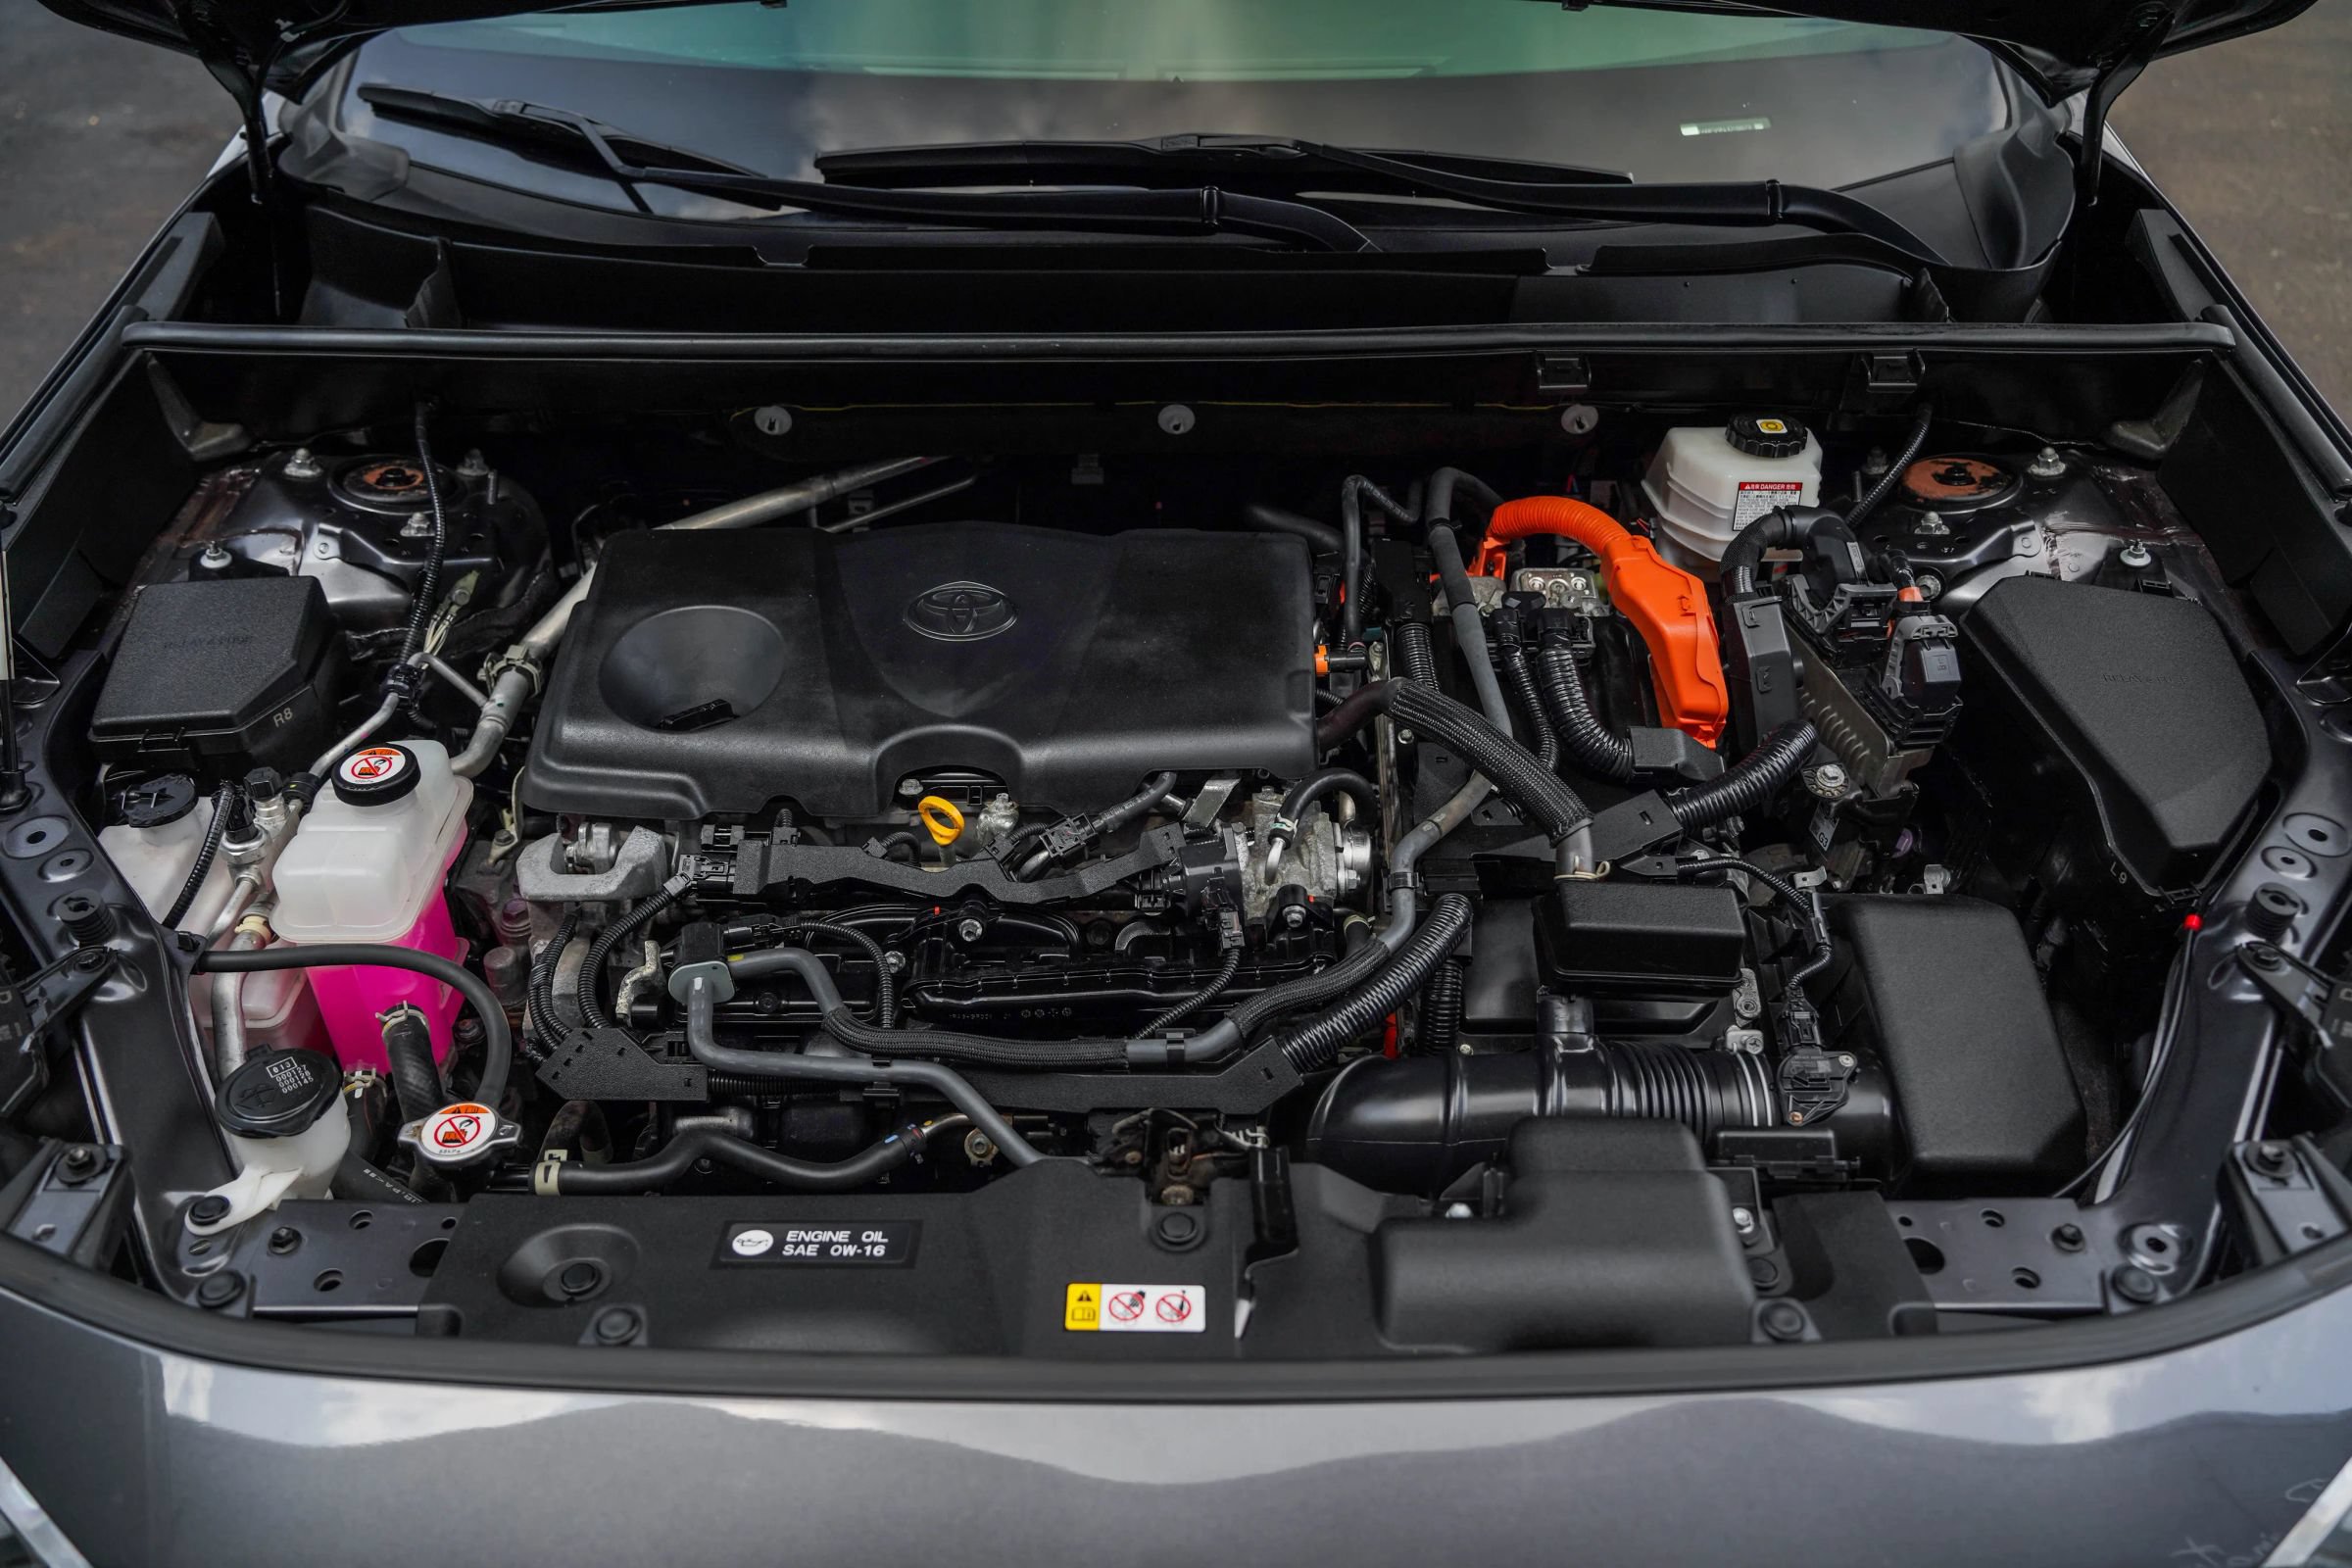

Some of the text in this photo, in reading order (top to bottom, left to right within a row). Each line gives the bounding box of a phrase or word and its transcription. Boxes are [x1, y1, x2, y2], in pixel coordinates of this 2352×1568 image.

[273, 707, 294, 727] R8
[786, 1230, 889, 1243] ENGINE OIL
[782, 1244, 886, 1257] SAE 0W-16
